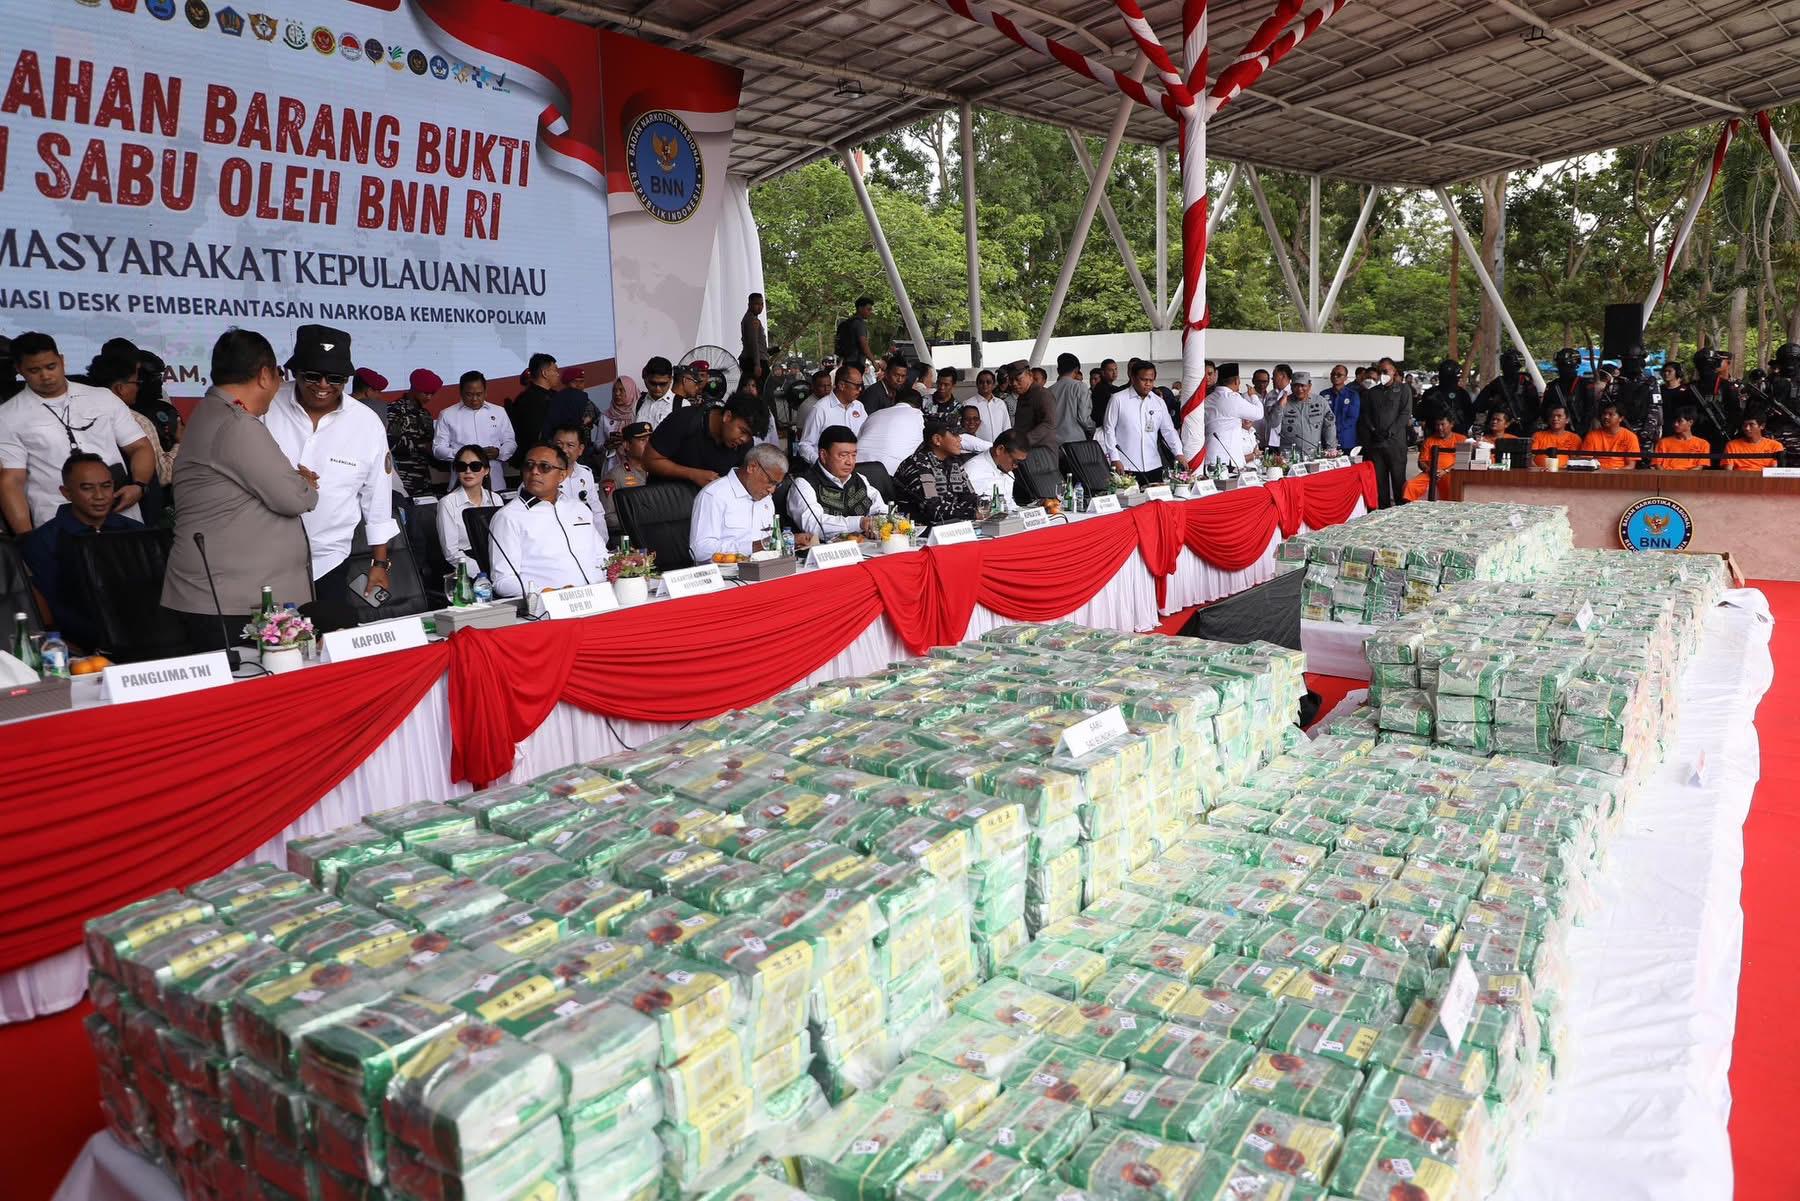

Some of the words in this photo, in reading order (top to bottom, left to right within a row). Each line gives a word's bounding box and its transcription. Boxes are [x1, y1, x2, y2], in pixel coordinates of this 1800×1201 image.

[1, 49, 182, 137] AHAN
[203, 84, 400, 169] BARANG
[416, 121, 531, 188] BUKTI
[629, 124, 643, 157] BADAN
[640, 112, 678, 128] NARKOTIKA
[678, 123, 701, 169] NASIONAL
[35, 132, 198, 211] SABU
[219, 157, 341, 225] OLEH
[357, 175, 450, 236] BNN
[464, 189, 502, 241] RI
[630, 171, 666, 220] REPUBLIK
[667, 182, 702, 221] INDONESIA
[650, 175, 684, 198] BNN
[0, 228, 287, 282] MASYARAKAT
[294, 250, 481, 294] KEPULAUAN
[485, 264, 547, 297] RIAU
[58, 291, 121, 313] DESK
[128, 294, 314, 319] PEMBERANTASAN
[319, 303, 406, 322] NARKOBA
[410, 306, 547, 325] KEMENKOPOLKAM
[1622, 507, 1635, 527] BADAN
[1635, 499, 1671, 510] NARKOTIKA
[1671, 503, 1691, 529] NASIONAL
[1640, 537, 1671, 548] BNN
[558, 590, 585, 602] KOMISI
[351, 630, 397, 650] KAPOLRI
[121, 668, 188, 689] PANGLIMA
[187, 664, 212, 680] TNI
